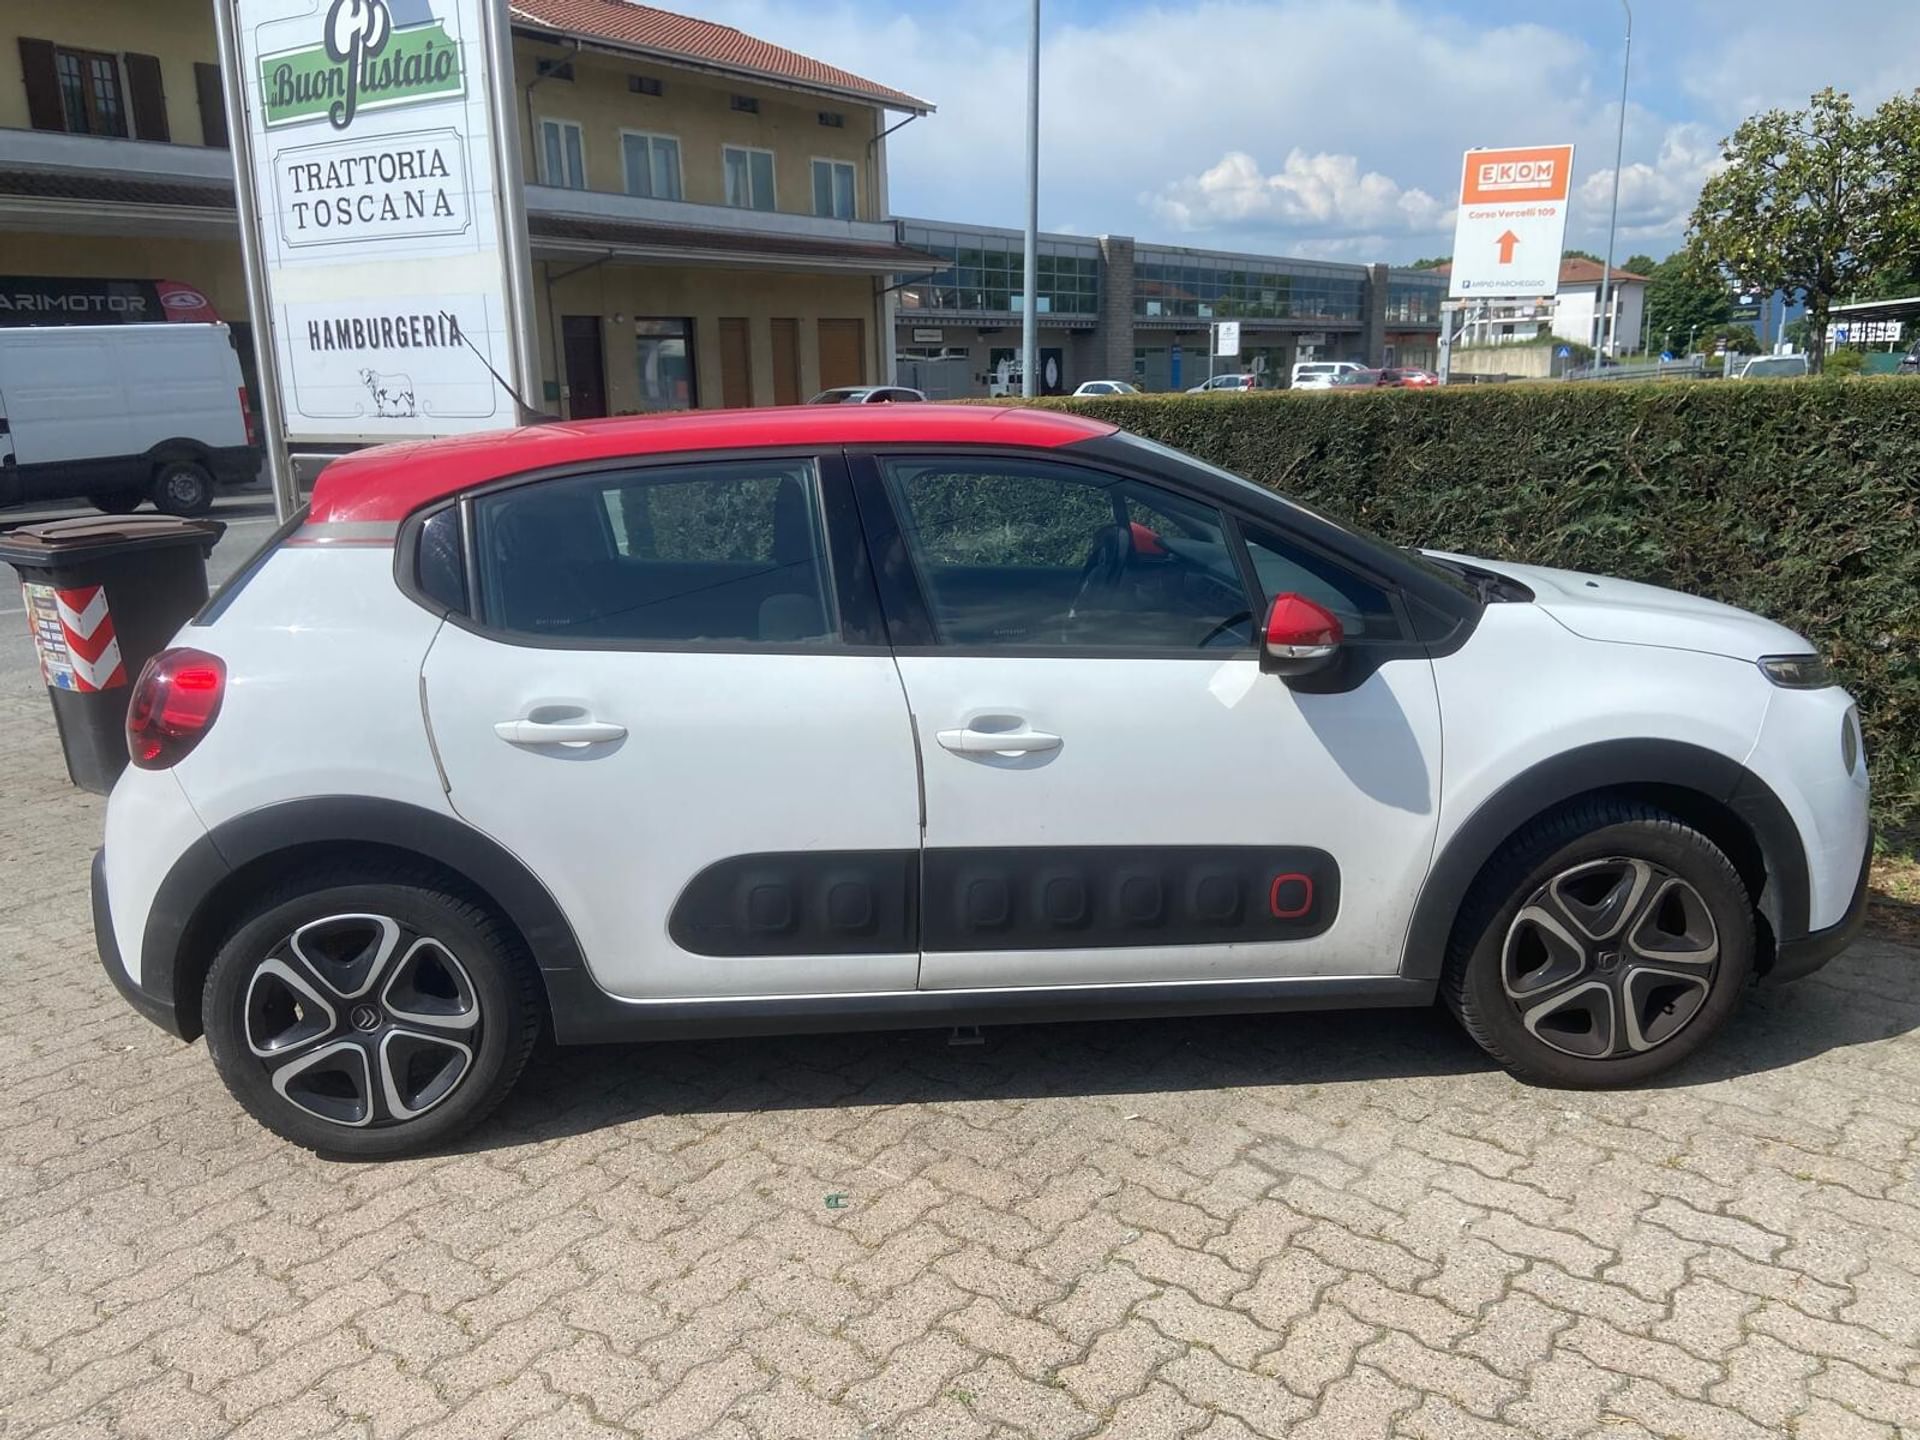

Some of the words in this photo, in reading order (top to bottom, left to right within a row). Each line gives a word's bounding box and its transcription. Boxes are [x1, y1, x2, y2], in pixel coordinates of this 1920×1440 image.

[273, 63, 345, 107] Buon
[288, 148, 450, 193] TRATTORIA
[1482, 163, 1551, 181] EKOM
[292, 188, 455, 229] TOSCANA
[1469, 210, 1497, 219] Corso
[1500, 207, 1536, 218] Vercelli
[1538, 207, 1556, 217] 109
[308, 314, 463, 351] HAMBURGERIA
